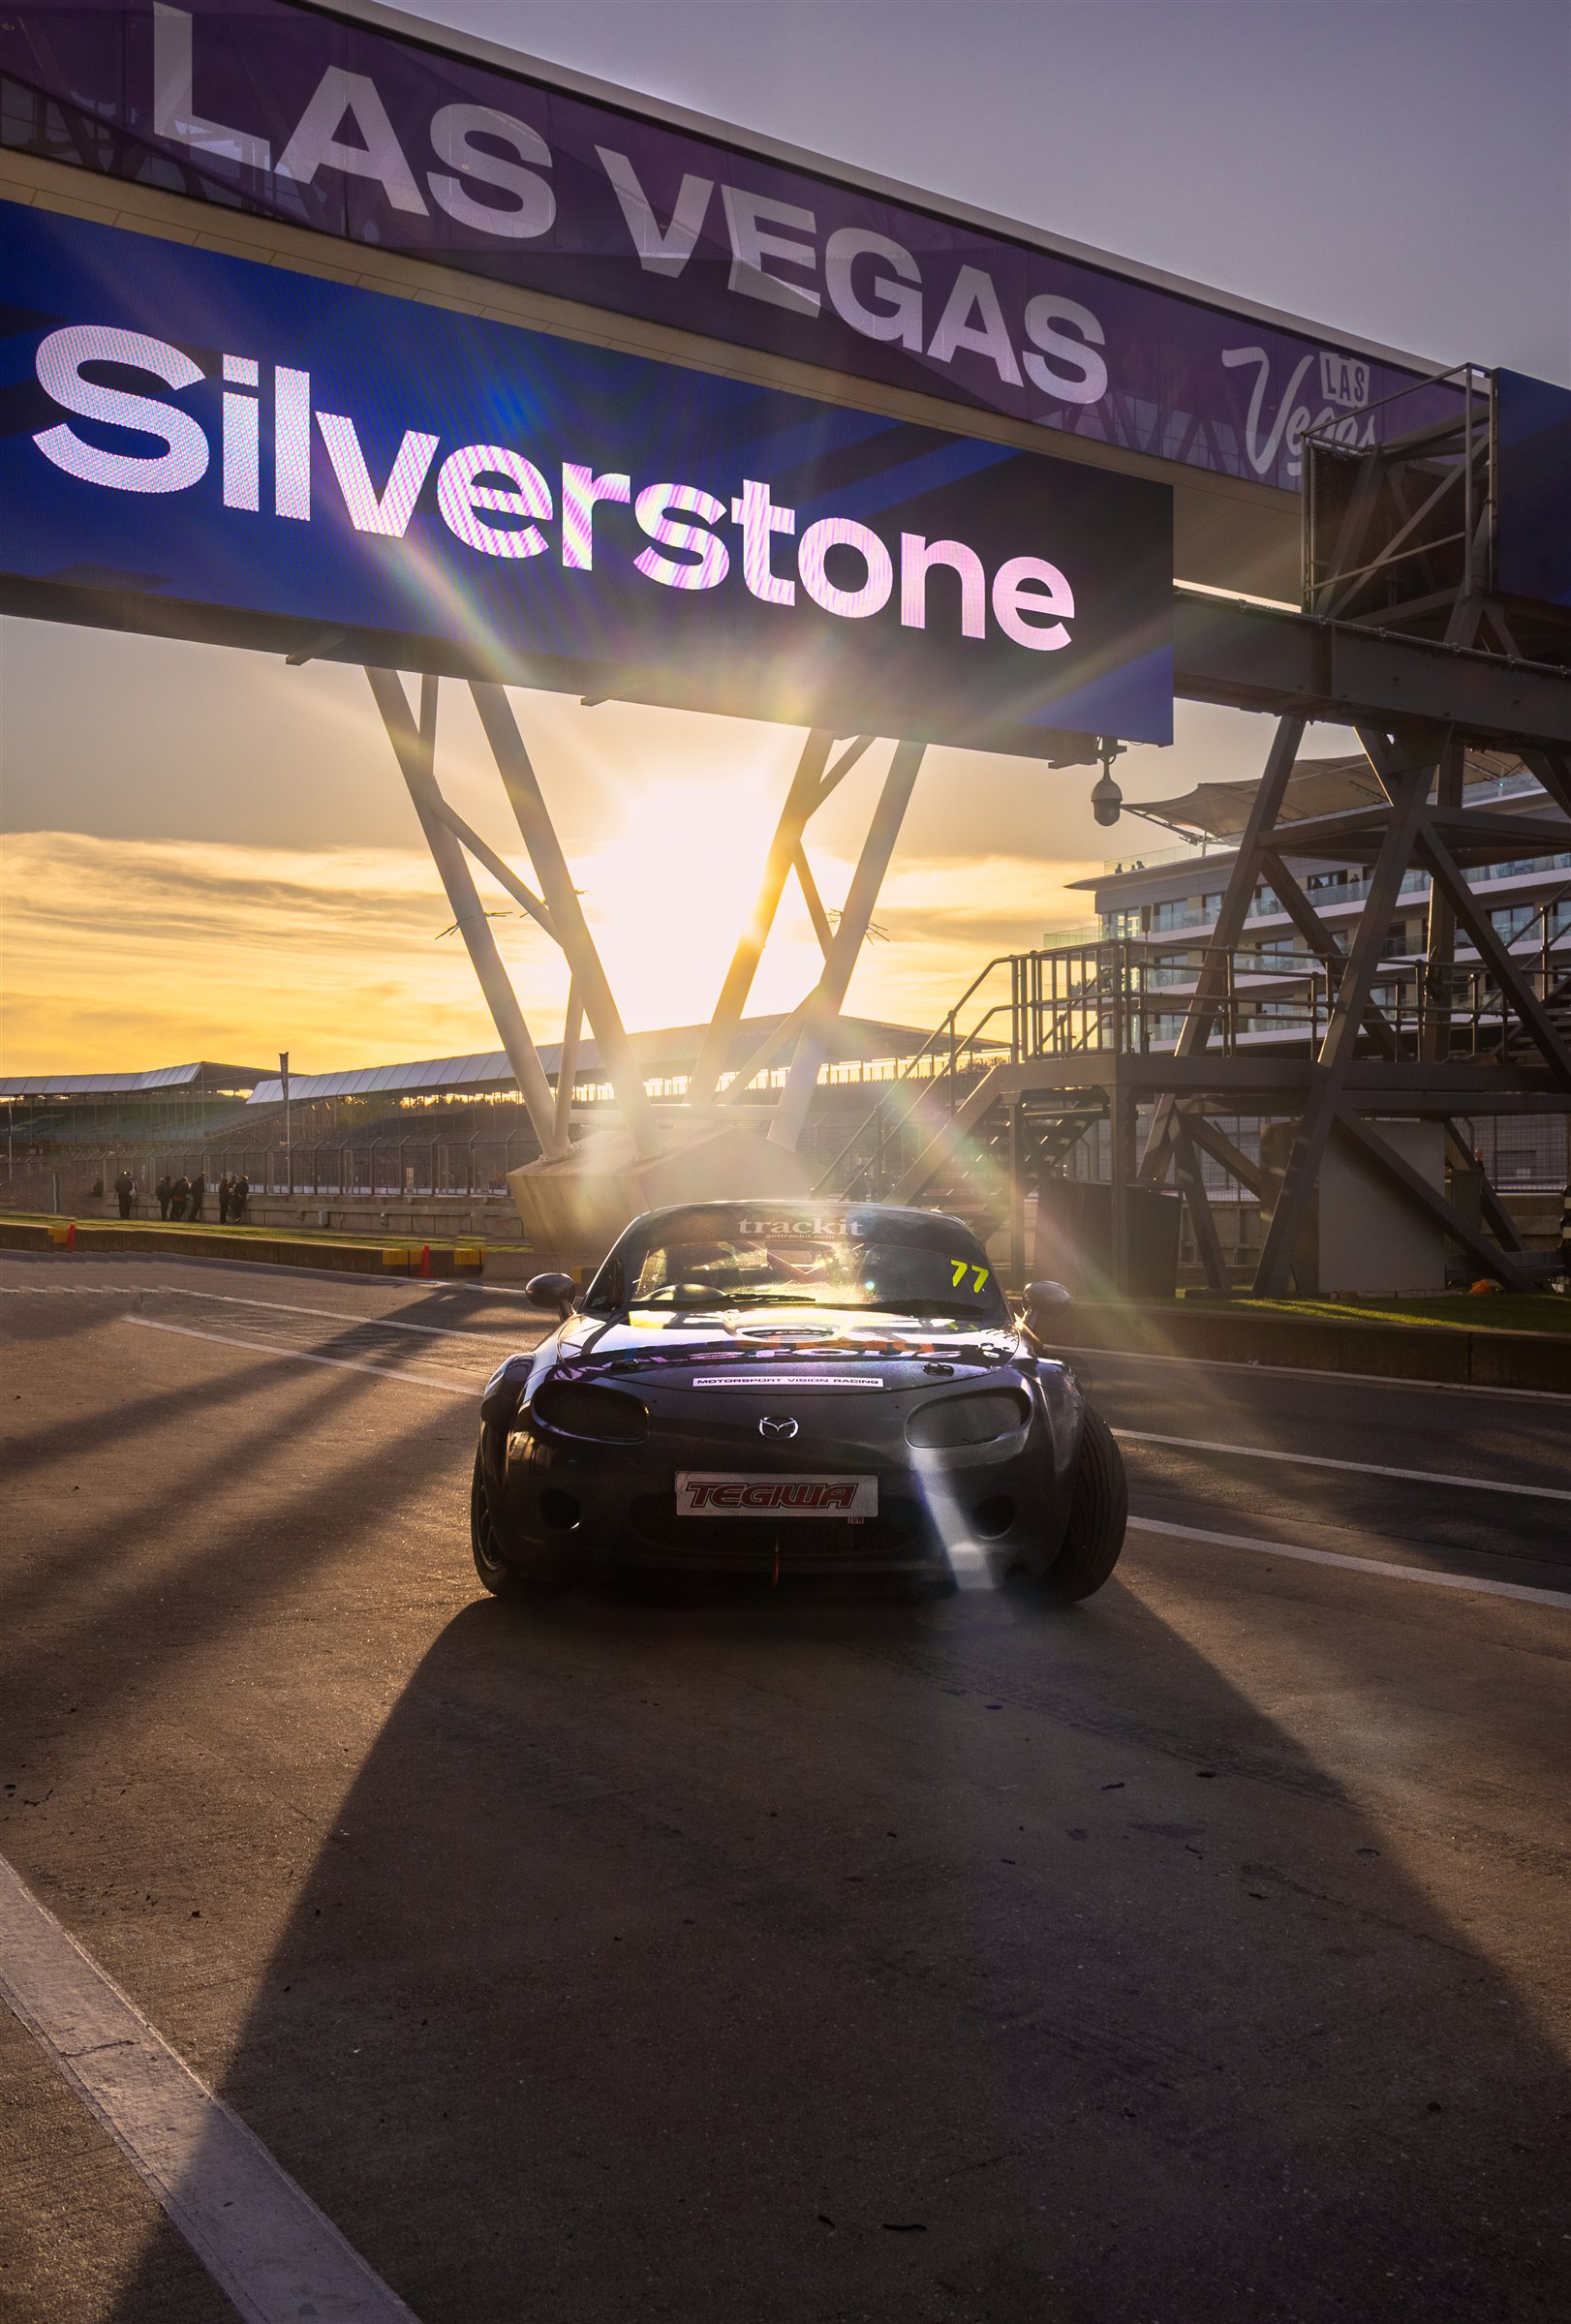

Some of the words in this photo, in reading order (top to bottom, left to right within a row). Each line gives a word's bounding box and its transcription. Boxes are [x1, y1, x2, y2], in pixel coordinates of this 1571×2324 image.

[153, 1, 557, 239] LAS
[594, 144, 1109, 405] VEGAS
[1324, 357, 1366, 402] LAS
[32, 324, 1075, 652] Silverstone
[738, 1217, 865, 1237] trackit
[950, 1260, 989, 1294] 77
[686, 1482, 859, 1509] TEGIWA
